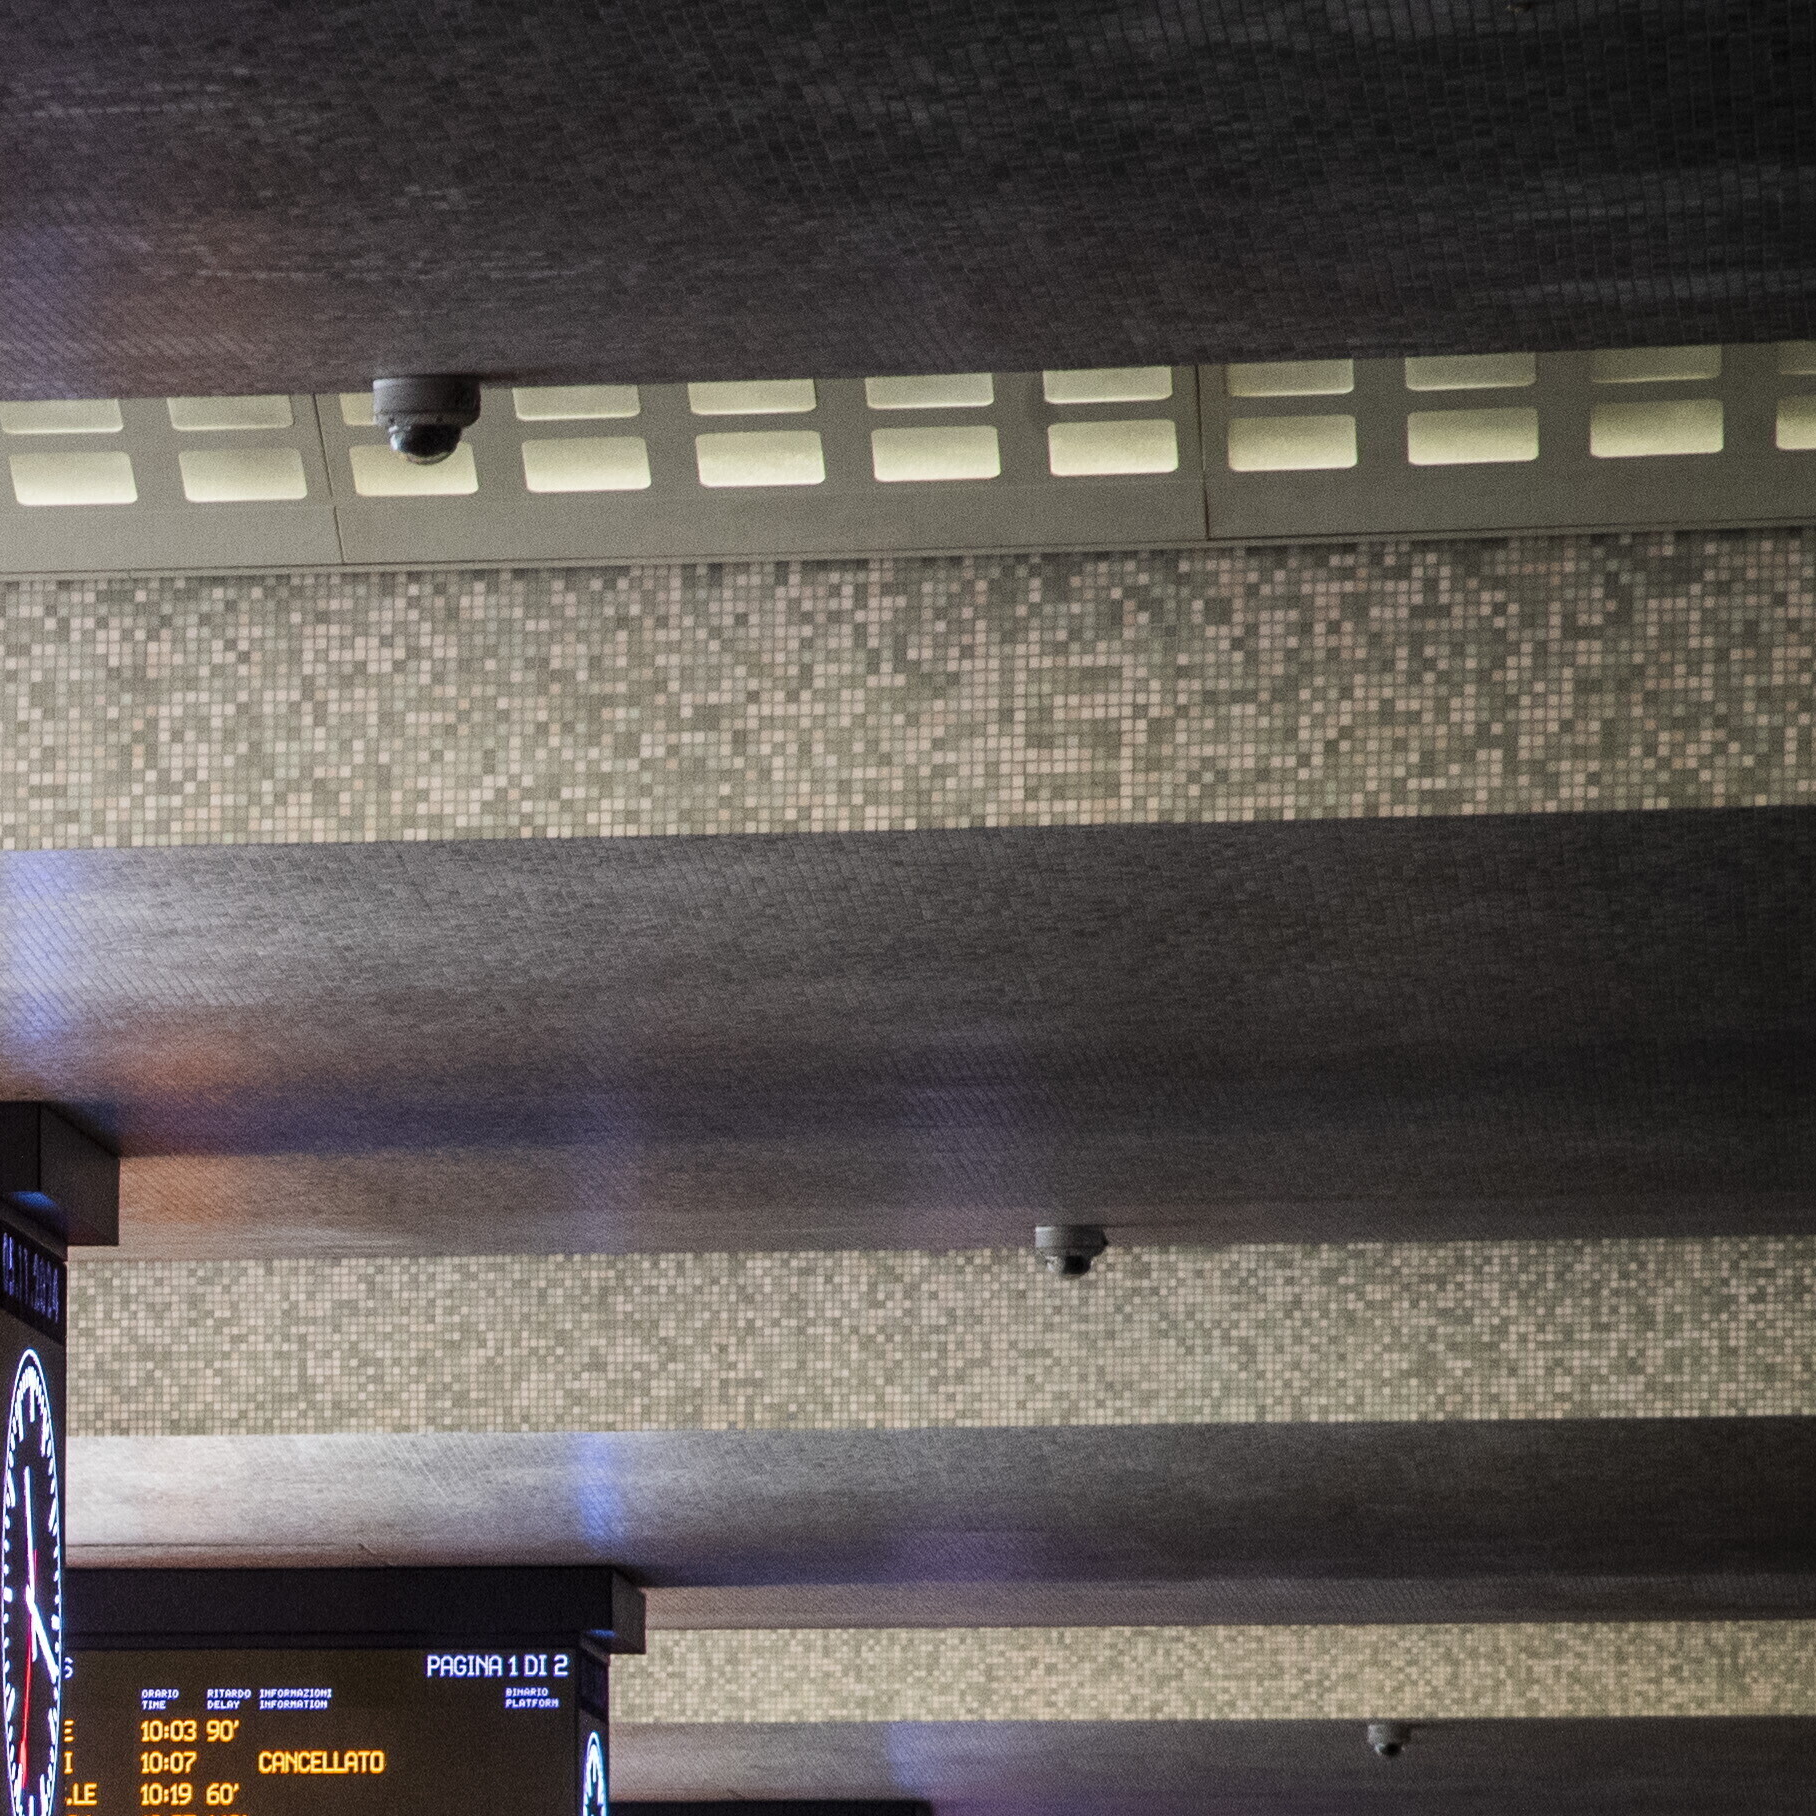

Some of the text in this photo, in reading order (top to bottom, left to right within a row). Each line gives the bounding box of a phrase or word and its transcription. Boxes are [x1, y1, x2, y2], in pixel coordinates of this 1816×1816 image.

[427, 1654, 568, 1678] PAGINA 1 DI 2
[141, 1719, 239, 1742] 10:03 90'
[141, 1750, 385, 1774] 10:07 CANCELLATO
